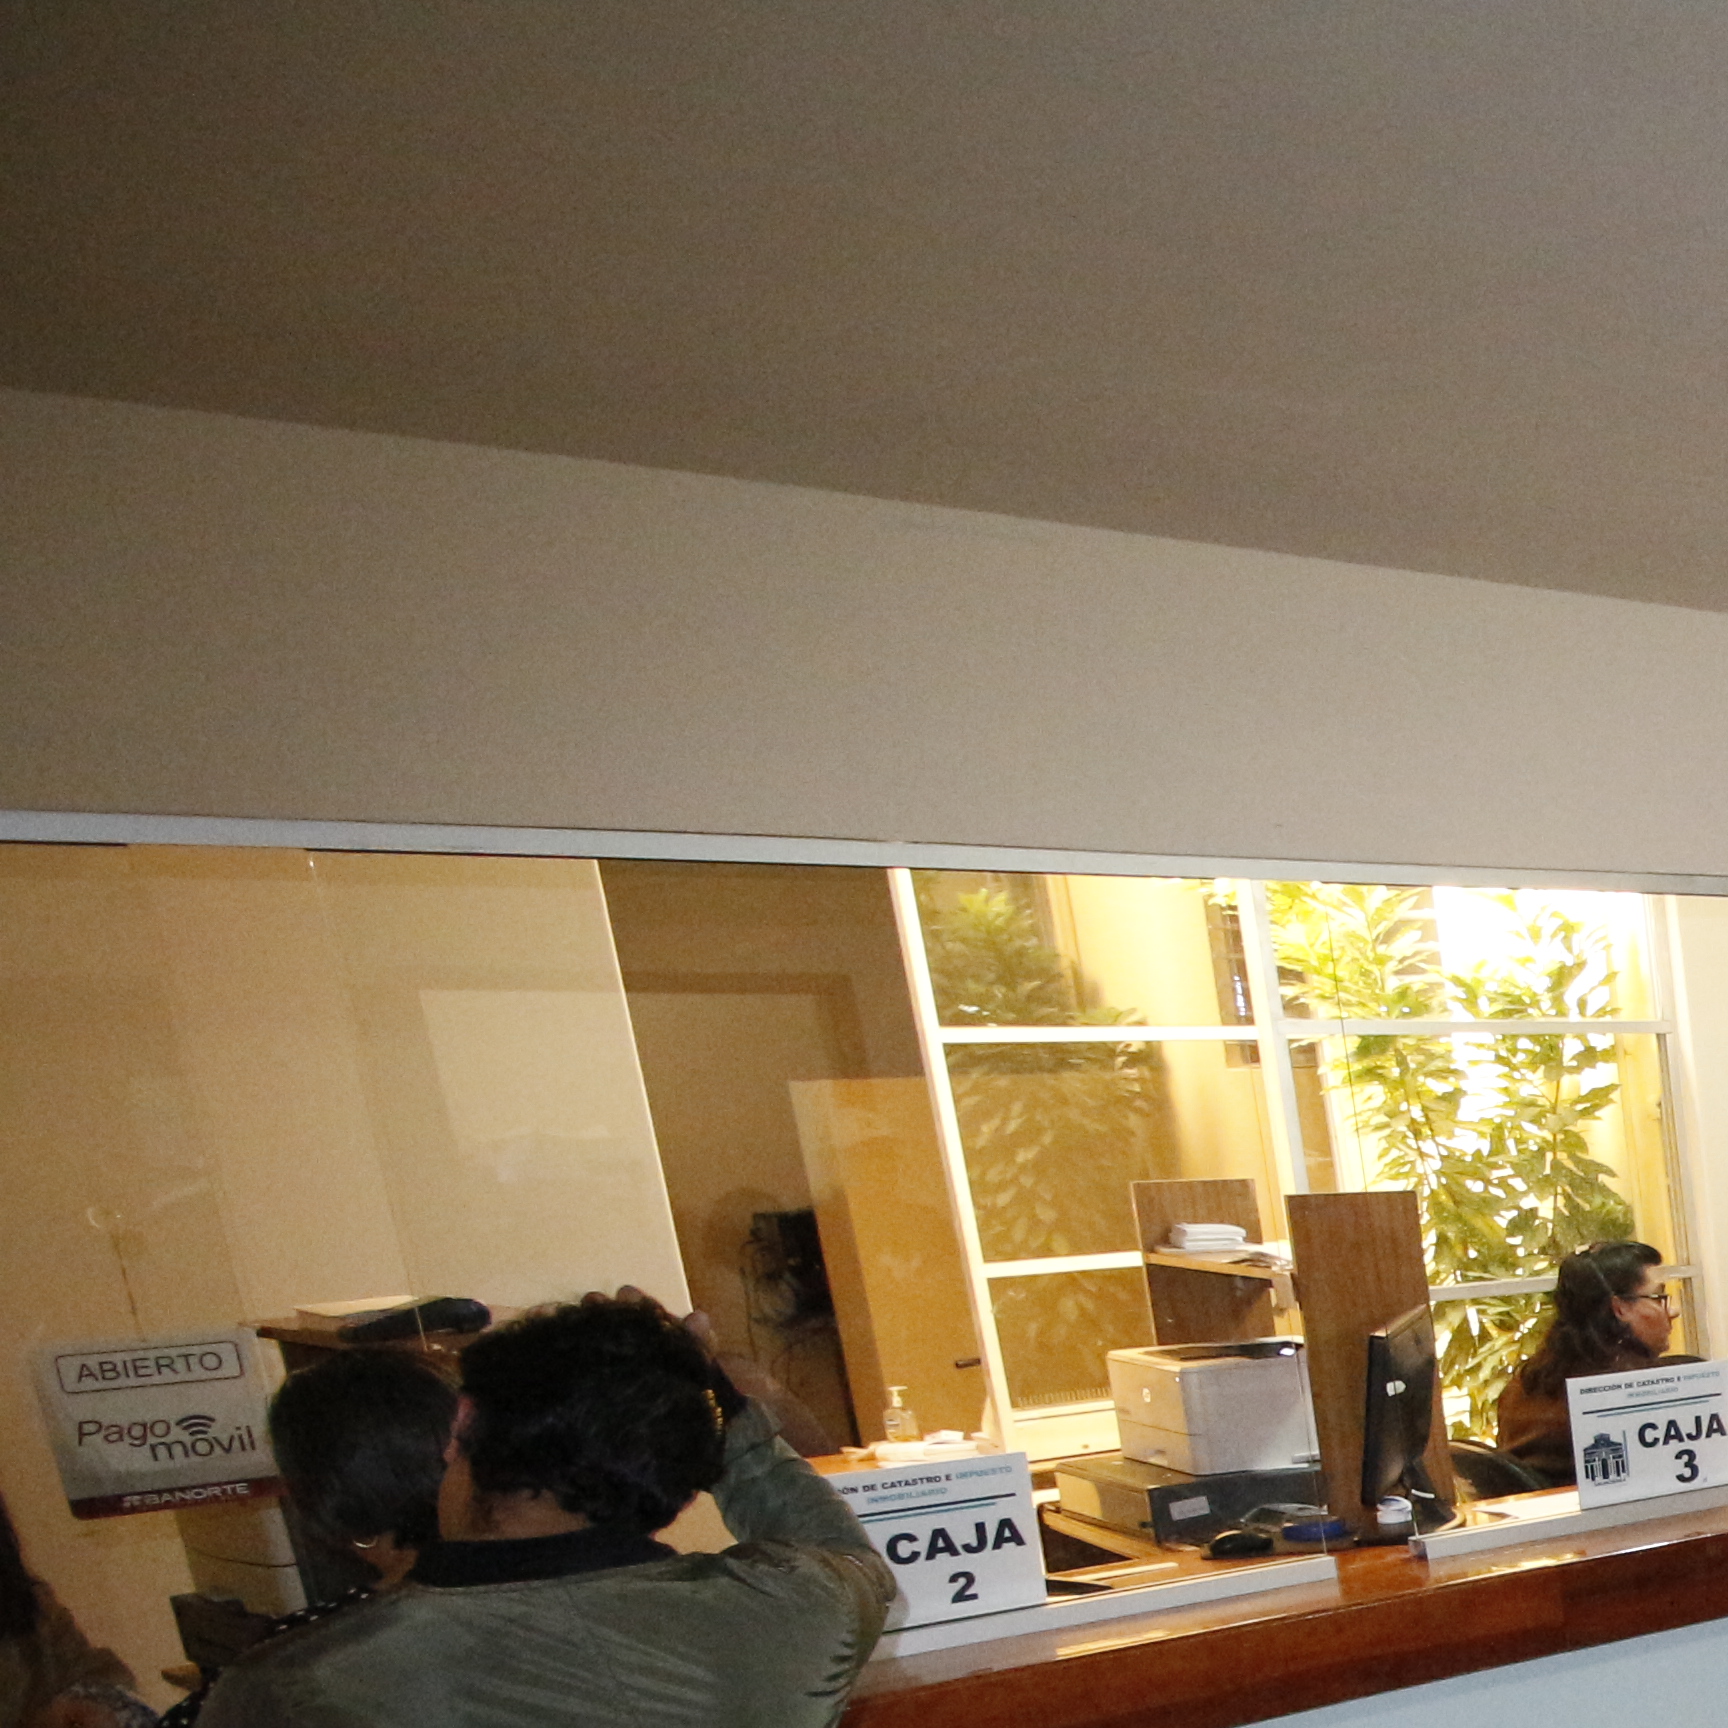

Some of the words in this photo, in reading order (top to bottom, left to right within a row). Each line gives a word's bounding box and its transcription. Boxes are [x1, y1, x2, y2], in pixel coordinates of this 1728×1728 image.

[77, 1352, 222, 1384] ABIERTO
[78, 1419, 171, 1447] Pago
[1638, 1412, 1727, 1448] CAJA
[1674, 1449, 1699, 1483] 3
[146, 1483, 249, 1504] BANORTE
[862, 1483, 877, 1493] DE
[881, 1475, 942, 1490] CATASTRO
[886, 1517, 1026, 1565] CAJA
[948, 1570, 979, 1604] 2
